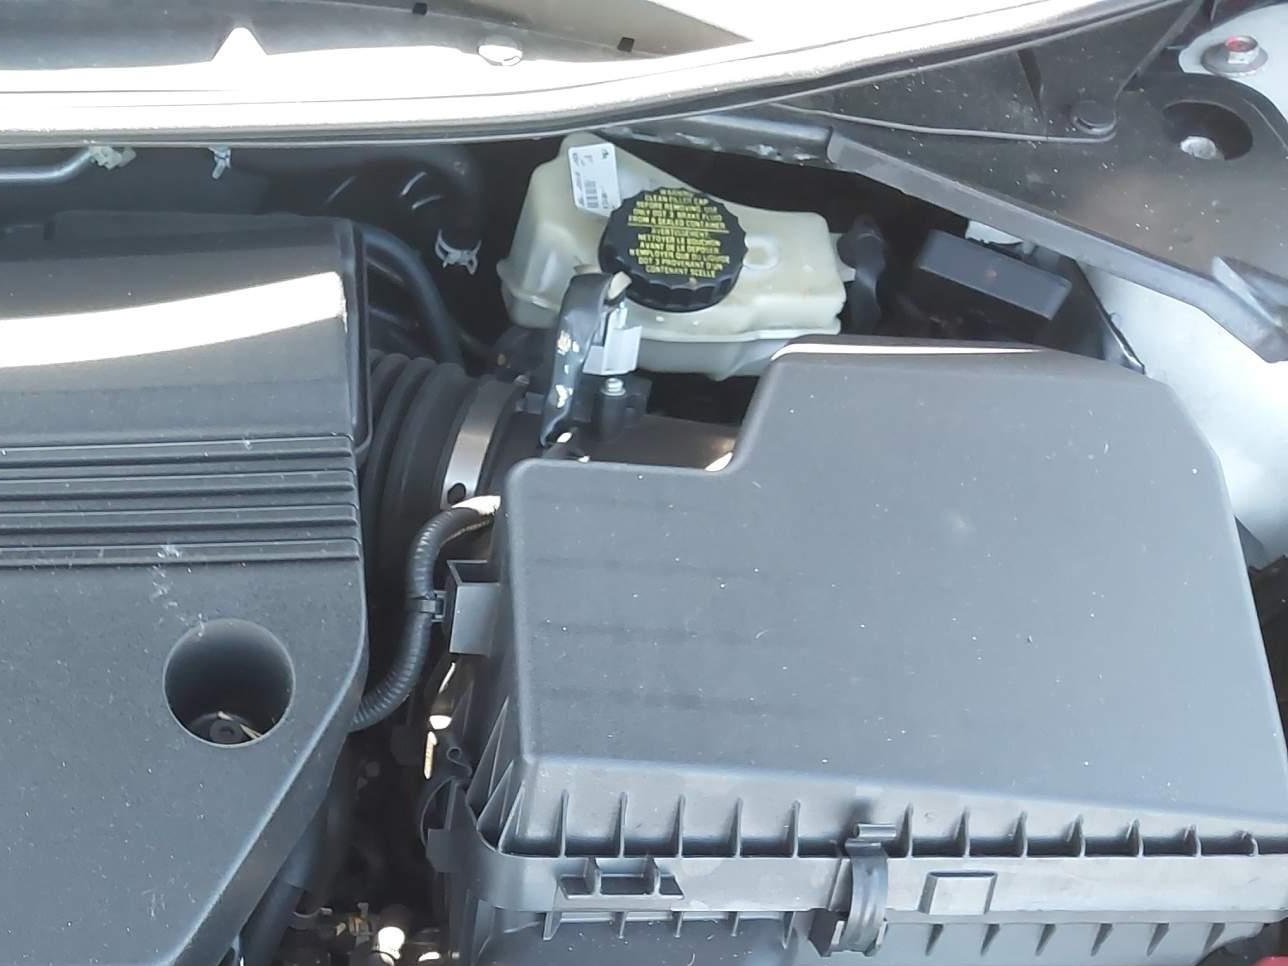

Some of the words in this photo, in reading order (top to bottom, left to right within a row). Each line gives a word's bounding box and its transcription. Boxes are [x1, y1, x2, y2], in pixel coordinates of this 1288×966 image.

[644, 194, 668, 202] CLEAN
[636, 201, 663, 209] BEFORE
[664, 203, 701, 212] REMOVING
[633, 208, 650, 216] ONLY
[677, 212, 700, 220] BRAKE
[702, 214, 722, 222] FLUID
[628, 215, 650, 223] FROM
[658, 218, 685, 226] SEALED
[686, 221, 726, 229] CONTAINER
[638, 234, 675, 243] NETTOYER
[686, 238, 721, 247] BOUCHON
[640, 241, 665, 250] AVANT
[666, 243, 675, 251] DE
[638, 257, 652, 265] DOT
[662, 259, 704, 269] PROVENANT
[675, 252, 690, 260] QUE
[691, 253, 702, 261] DU
[703, 255, 730, 264] LIQUIDE
[645, 265, 688, 275] CONTENANT
